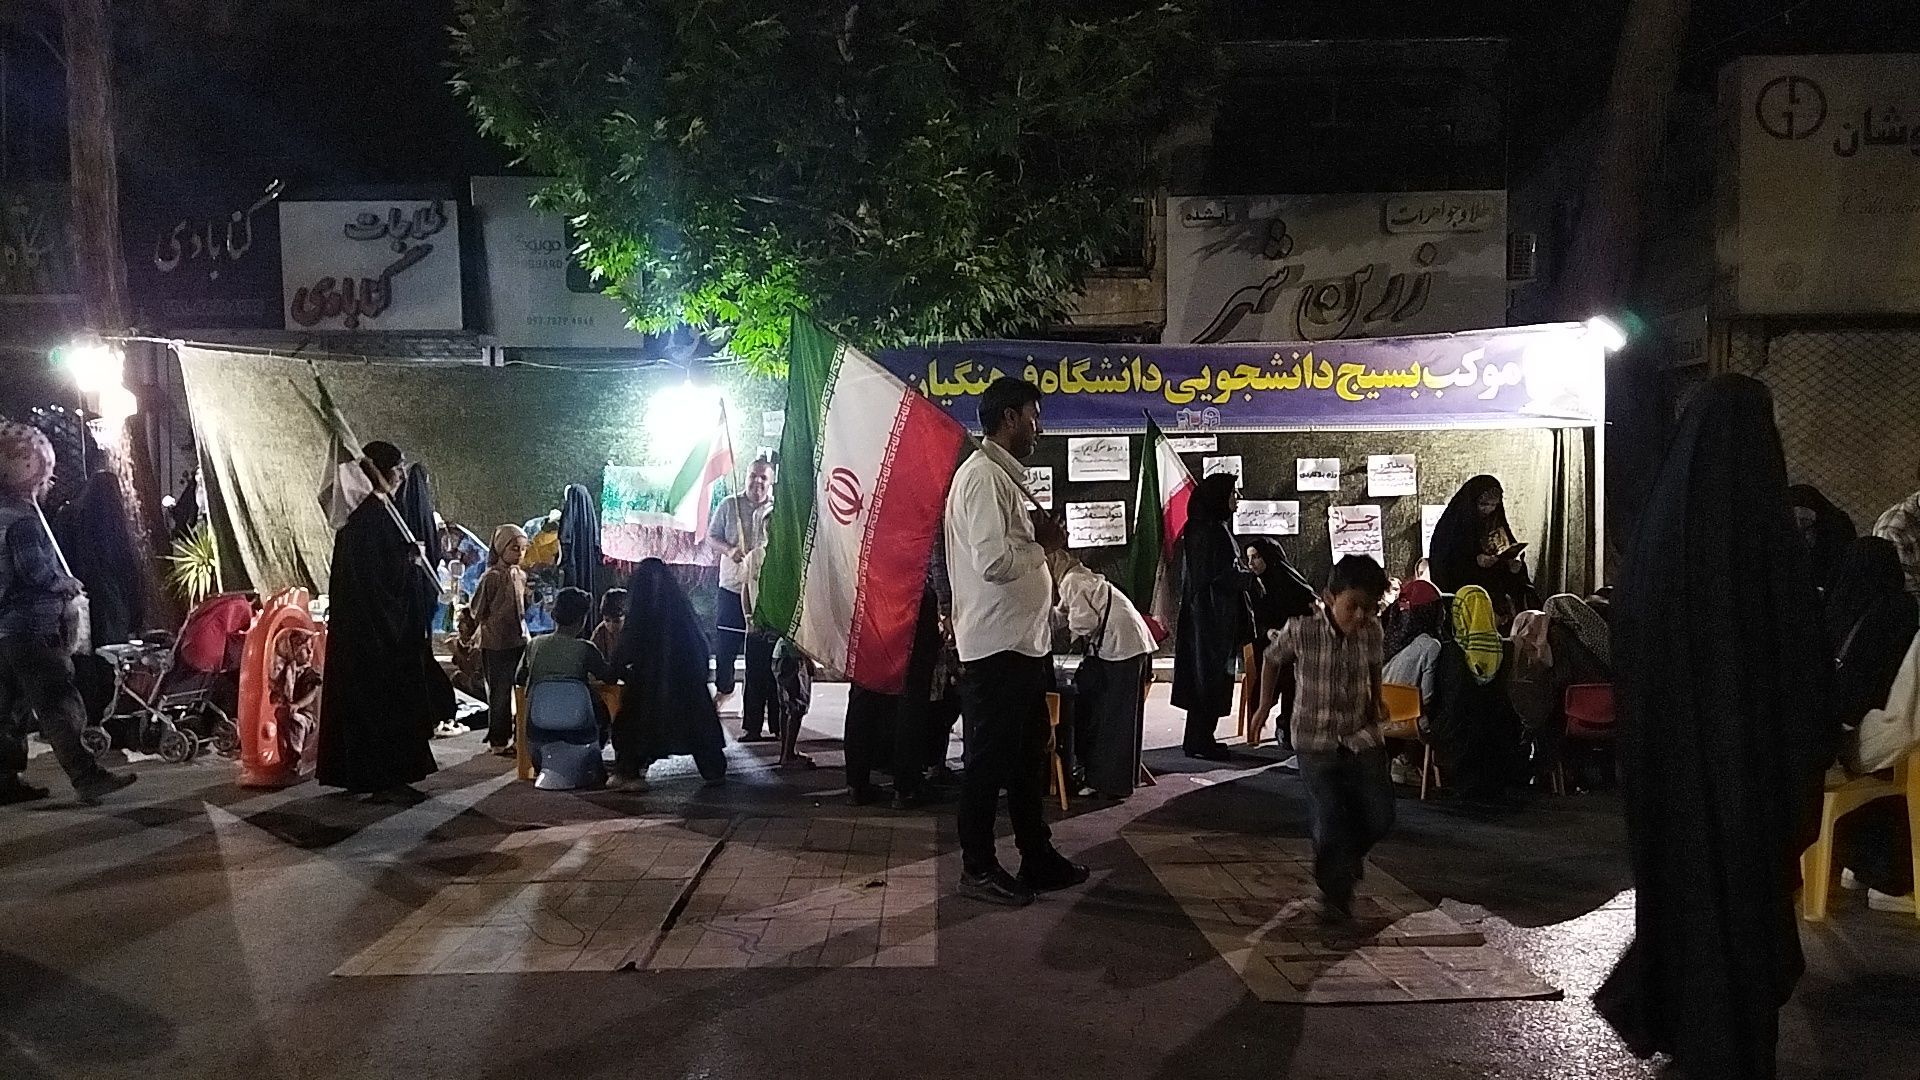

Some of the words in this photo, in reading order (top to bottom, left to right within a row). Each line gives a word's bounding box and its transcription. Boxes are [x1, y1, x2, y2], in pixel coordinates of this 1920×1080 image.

[153, 179, 286, 280] گنابادی
[1391, 199, 1461, 228] جواهرات
[290, 244, 435, 328] گنابادی
[1040, 354, 1163, 396] دانشگاه
[1164, 350, 1334, 405] دانشجویی
[1335, 361, 1421, 402] بسیج
[1421, 348, 1523, 400] موکب
